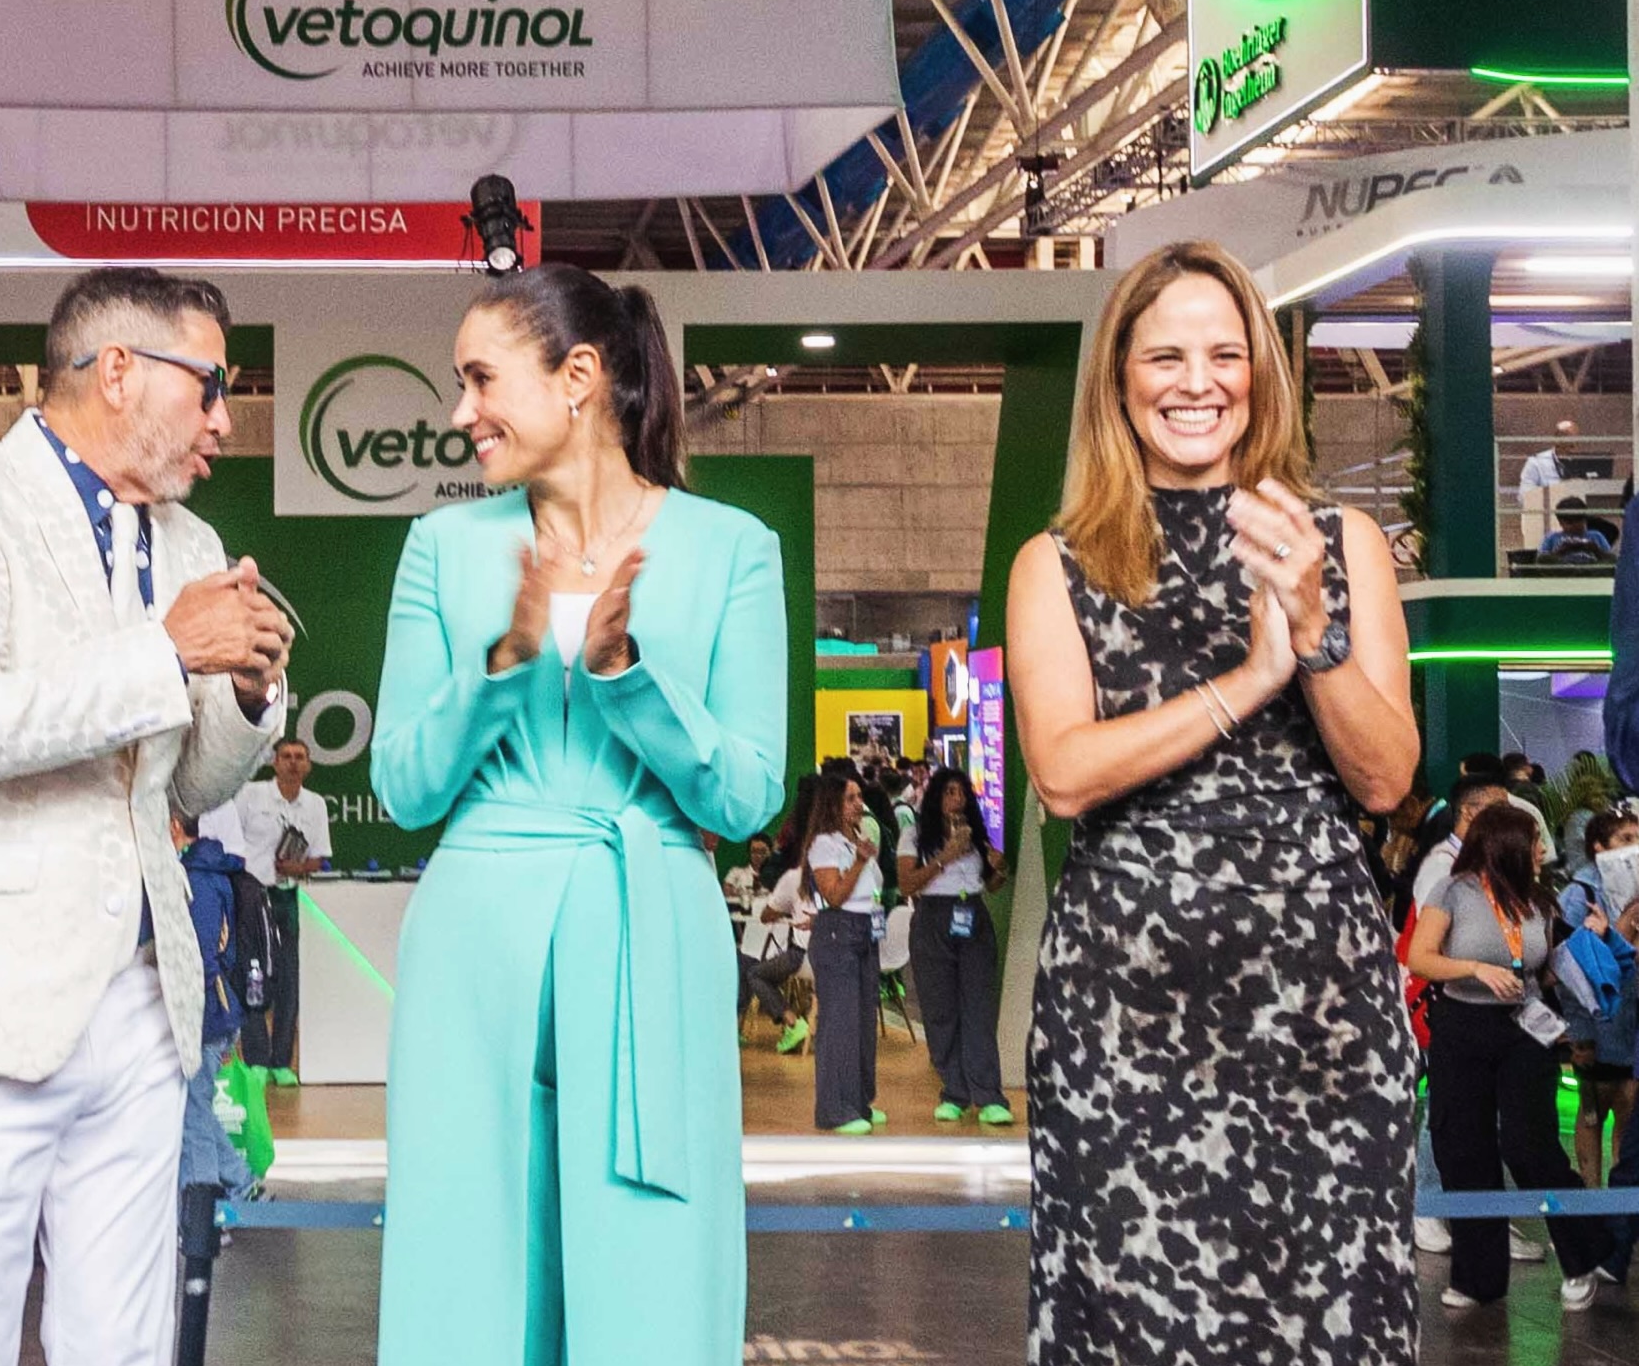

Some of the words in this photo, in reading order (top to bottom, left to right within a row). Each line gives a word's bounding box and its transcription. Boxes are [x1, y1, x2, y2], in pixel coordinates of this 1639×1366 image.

[362, 61, 435, 79] ACHIEVE
[440, 61, 489, 78] MORE
[494, 61, 585, 78] TOGETHER
[277, 206, 408, 234] PRECISA
